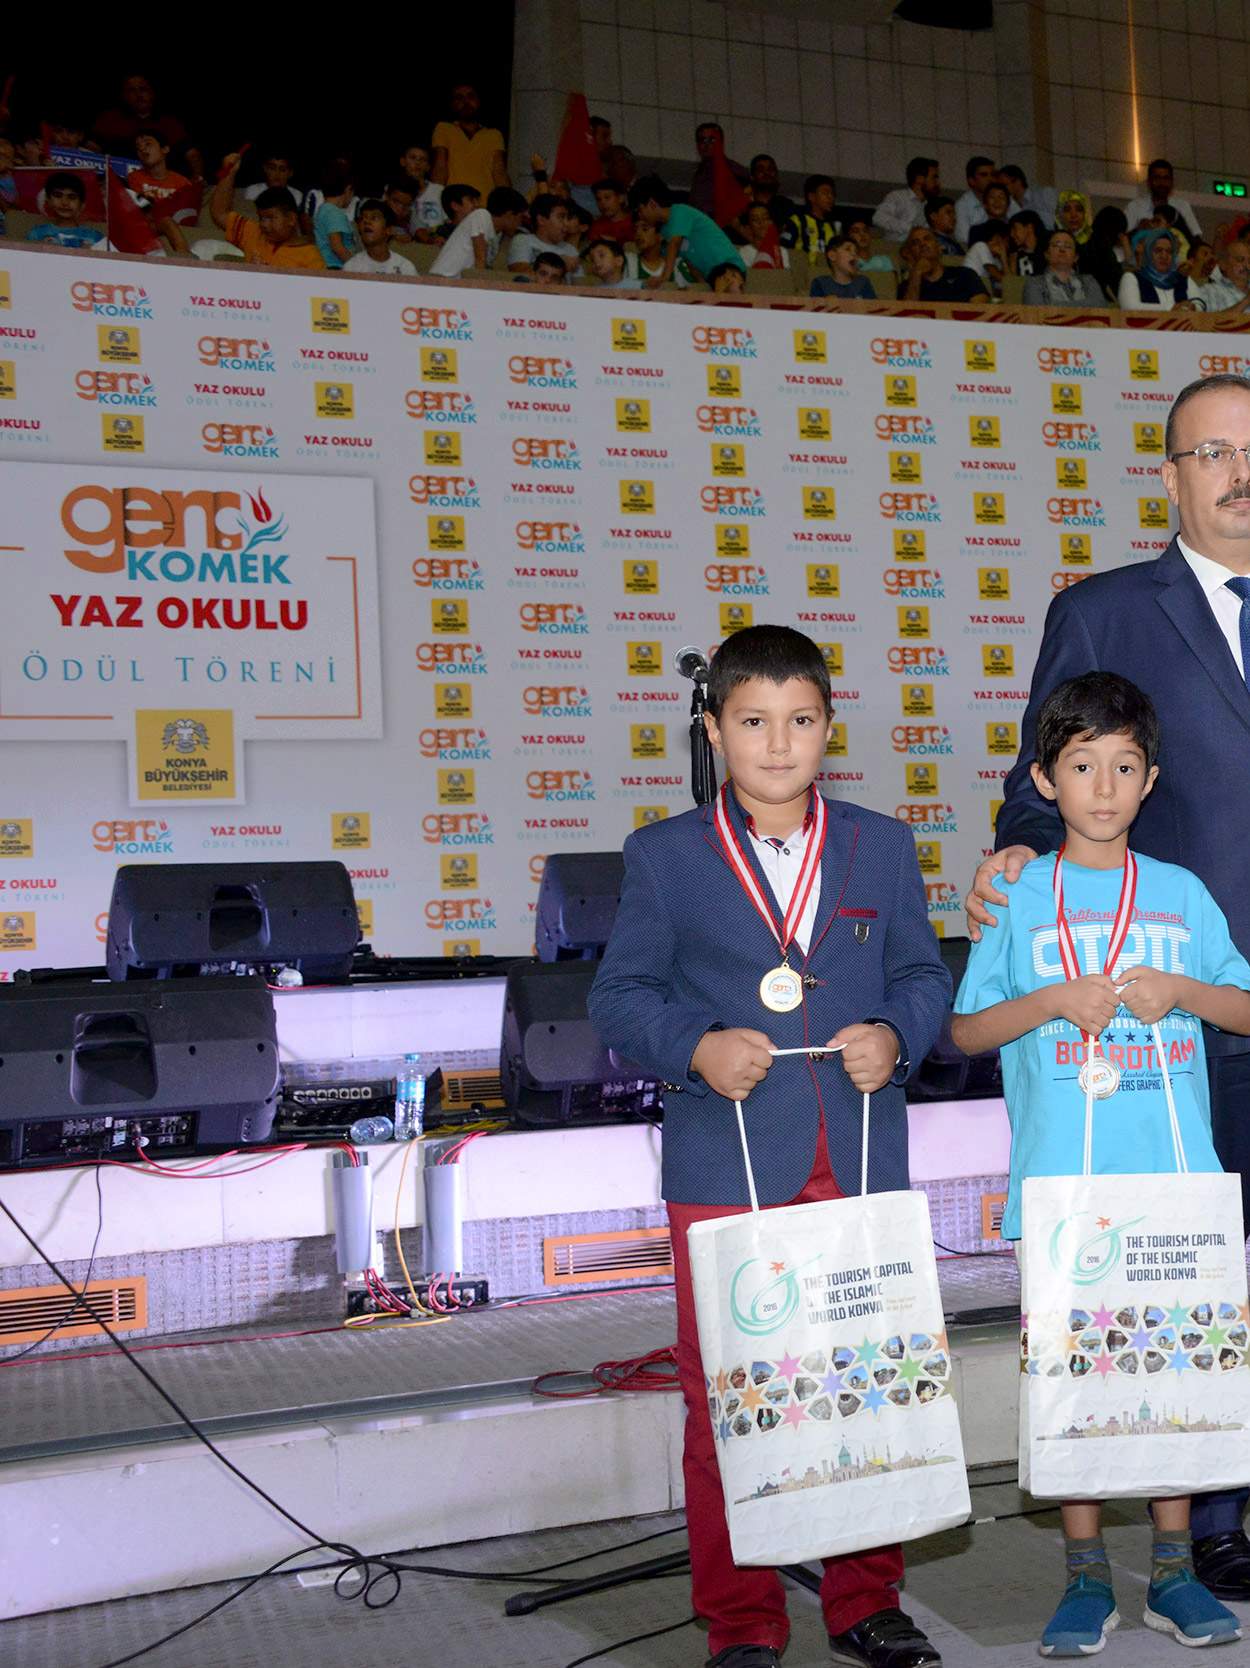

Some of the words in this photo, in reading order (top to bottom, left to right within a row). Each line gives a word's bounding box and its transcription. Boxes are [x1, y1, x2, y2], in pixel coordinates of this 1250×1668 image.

[189, 295, 214, 306] YAZ
[217, 297, 261, 310] OKULU
[94, 305, 153, 320] KOMEK
[503, 318, 525, 327] YAZ
[527, 319, 566, 330] OKULU
[0, 327, 36, 339] KULU
[300, 349, 323, 359] YAZ
[327, 350, 368, 361] OKULU
[220, 358, 276, 372] KOMEK
[602, 366, 623, 375] YAZ
[626, 367, 663, 376] OKULU
[785, 375, 804, 384] YAZ
[807, 375, 842, 385] OKULU
[194, 383, 218, 394] YAZ
[221, 384, 264, 396] OKULU
[956, 383, 975, 392] YAZ
[977, 384, 1011, 394] OKULU
[98, 392, 158, 407] KOMEK
[1121, 391, 1139, 400] YAZ
[1141, 392, 1173, 401] OKULU
[304, 435, 328, 445] YAZ
[330, 435, 372, 447] OKULU
[223, 444, 280, 458] KOMEK
[789, 453, 808, 462] YAZ
[811, 453, 847, 464] OKULU
[511, 483, 532, 492] YAZ
[535, 484, 574, 494] OKULU
[60, 485, 243, 573] genç
[610, 528, 632, 537] YAZ
[634, 528, 671, 538] OKULU
[965, 537, 984, 545] YAZ
[987, 537, 1020, 546] OKULU
[127, 550, 292, 584] KOMEK
[50, 594, 143, 628] YAZ
[156, 597, 309, 631] OKULU
[797, 612, 816, 621] YAZ
[820, 613, 855, 621] OKULU
[519, 649, 540, 658] YAZ
[543, 649, 581, 658] OKULU
[23, 650, 145, 682] ÖDÜL
[175, 655, 336, 683] TÖRENİ
[973, 690, 992, 699] YAZ
[995, 690, 1029, 699] OKULU
[165, 758, 207, 769] KONYA
[144, 768, 228, 783] BÜYÜKŞEHİR
[621, 776, 641, 785] YAZ
[645, 775, 682, 785] OKULU
[162, 783, 212, 791] BELEDİYESİ
[524, 818, 546, 828] YAZ
[549, 818, 588, 828] OKULU
[210, 825, 235, 836] YAZ
[238, 825, 281, 835] OKULU
[114, 840, 174, 855] KOMEK
[10, 879, 57, 890] OKULU
[1062, 907, 1118, 924] Californi
[1040, 1022, 1065, 1037] SINCE
[1126, 1236, 1145, 1248] THE
[1146, 1235, 1190, 1248] TOURISM
[1191, 1233, 1227, 1247] CAPITAL
[1126, 1253, 1139, 1265] OF
[1141, 1252, 1160, 1264] THE
[1161, 1251, 1199, 1264] ISLAMIC
[803, 1275, 824, 1291] THE
[825, 1267, 872, 1287] TOURISM
[874, 1261, 914, 1278] CAPITAL
[1126, 1269, 1162, 1281] WORLD
[1164, 1267, 1197, 1281] KONYA
[843, 1282, 884, 1302] ISLAMIC
[763, 1303, 777, 1312] 2016
[808, 1307, 847, 1325] WORLD
[849, 1300, 884, 1319] KONYA
